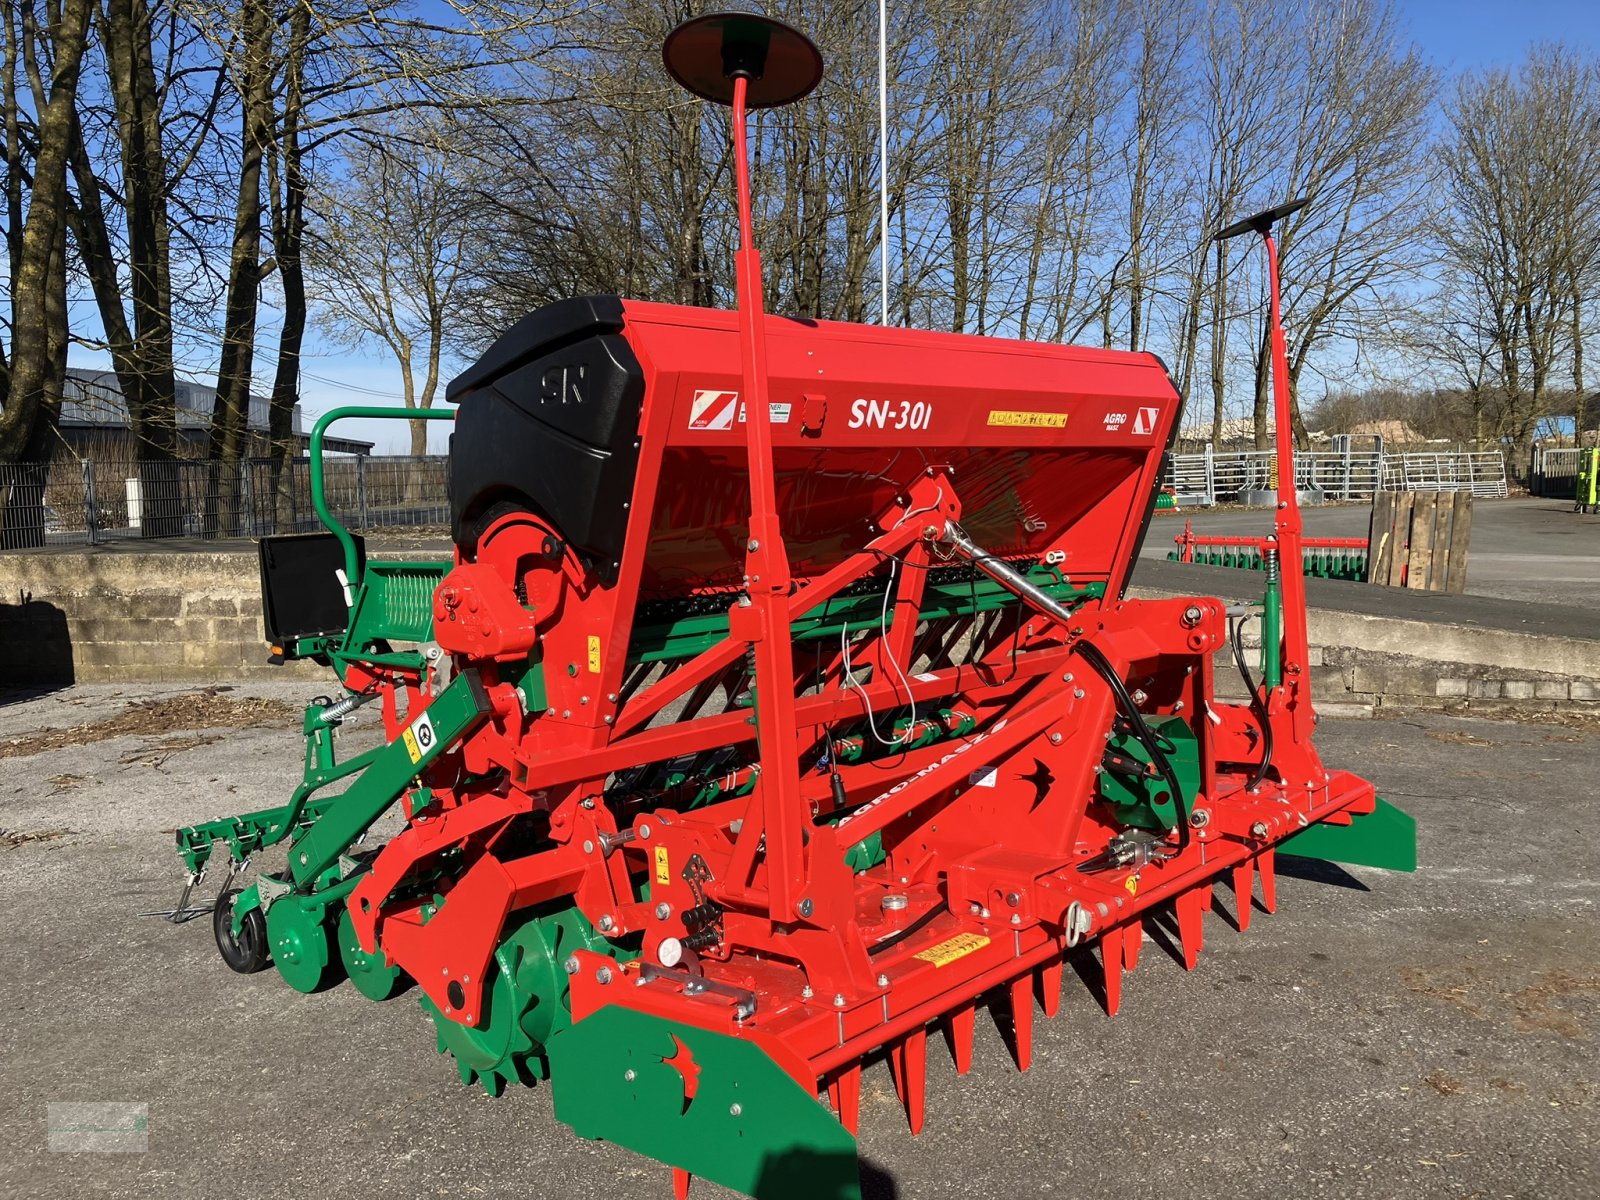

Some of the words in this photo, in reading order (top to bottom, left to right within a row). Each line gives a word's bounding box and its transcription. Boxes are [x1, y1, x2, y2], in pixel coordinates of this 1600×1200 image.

[539, 363, 589, 405] SN
[847, 398, 933, 430] SN-301
[1103, 413, 1127, 424] AGRO
[838, 732, 990, 828] AGRO-MASZ
